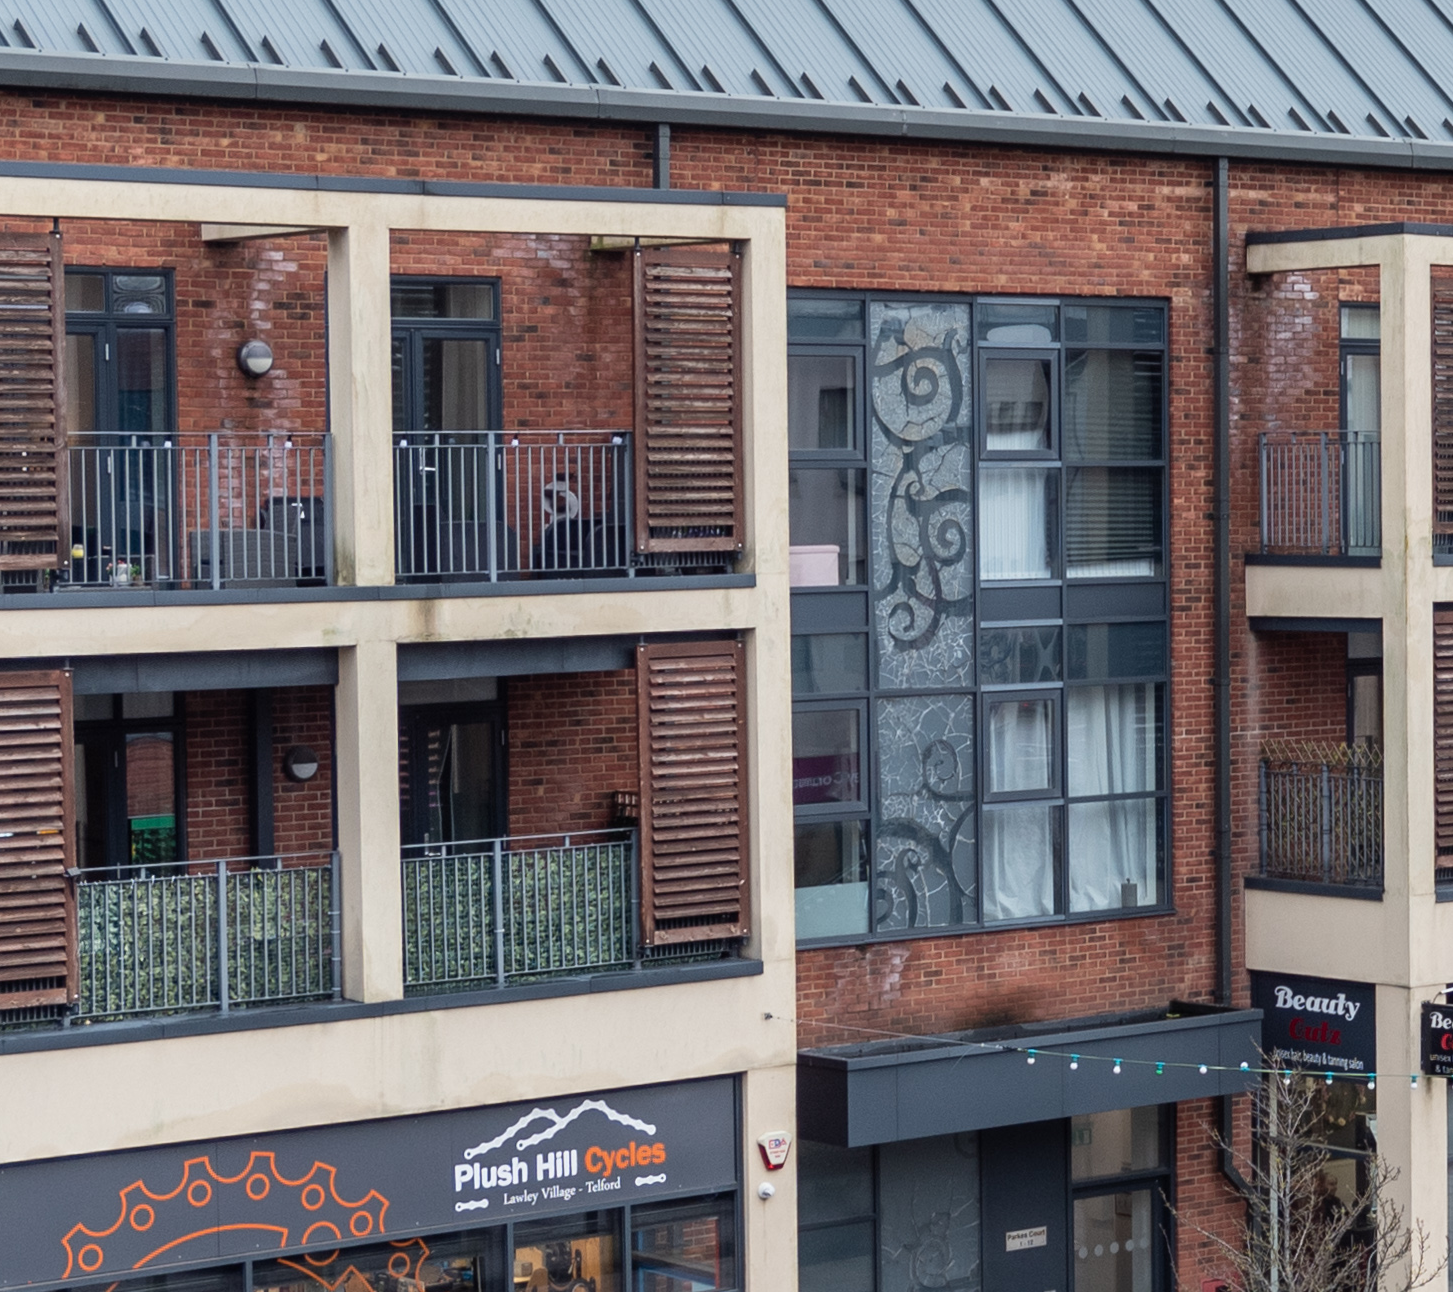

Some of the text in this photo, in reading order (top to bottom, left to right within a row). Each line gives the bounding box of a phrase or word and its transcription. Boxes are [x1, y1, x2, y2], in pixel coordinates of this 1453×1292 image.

[1274, 986, 1360, 1021] Beauty
[1289, 1017, 1341, 1046] Cutz
[1303, 1050, 1321, 1066] beauty
[1322, 1052, 1327, 1065] &
[1328, 1054, 1348, 1071] tanning
[1349, 1057, 1364, 1070] salon
[1429, 1053, 1451, 1062] unisex
[455, 1141, 666, 1192] Plush Hill Cycles
[503, 1190, 539, 1206] Lawley
[541, 1185, 577, 1200] Village
[585, 1177, 621, 1194] Telford
